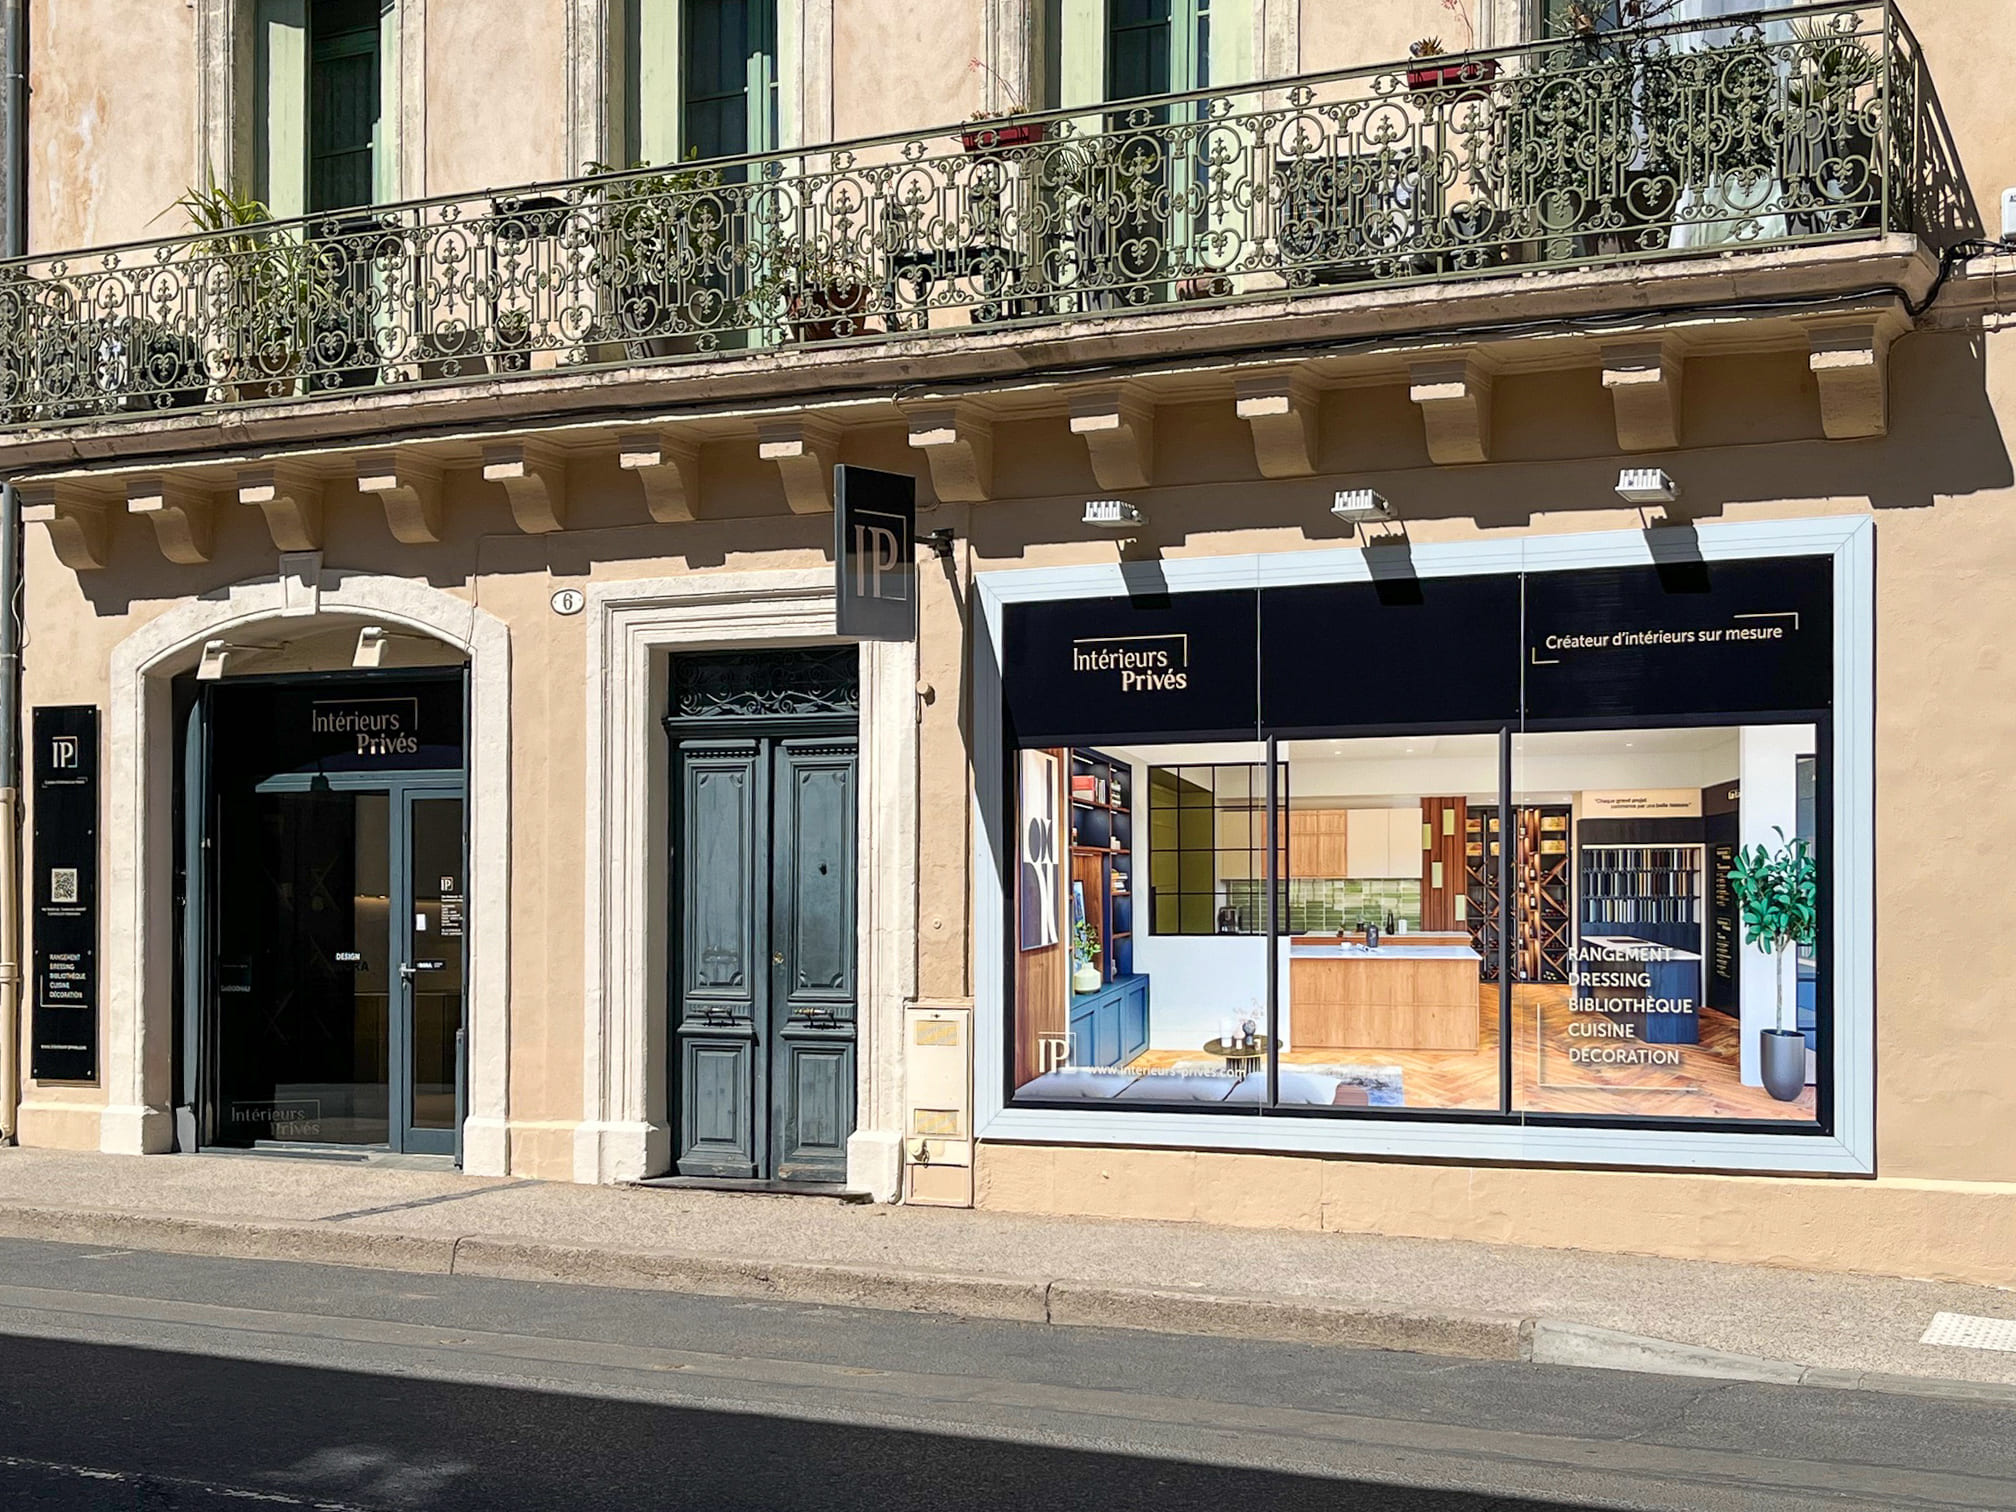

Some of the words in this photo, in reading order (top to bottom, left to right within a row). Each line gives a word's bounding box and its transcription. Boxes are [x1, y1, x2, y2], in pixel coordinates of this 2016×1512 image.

[852, 524, 899, 598] IP
[563, 592, 573, 611] 6
[1546, 634, 1609, 649] Créateur
[1612, 629, 1695, 645] d'intérieurs
[1698, 629, 1722, 641] sur
[1725, 626, 1783, 640] mesure
[1073, 647, 1168, 671] Intérieurs
[1121, 668, 1187, 692] Privés
[312, 709, 400, 732] Intérieurs
[357, 732, 418, 754] Privés
[52, 741, 74, 768] IP
[336, 952, 361, 961] DESIGN
[1568, 947, 1673, 962] RANGEMENT
[1568, 972, 1651, 987] DRESSING
[1568, 996, 1693, 1014] BIBLIOTHÈQUE
[1568, 1023, 1635, 1038] CUISINE
[1038, 1038, 1070, 1074] IP
[231, 1106, 305, 1122] Intérieurs
